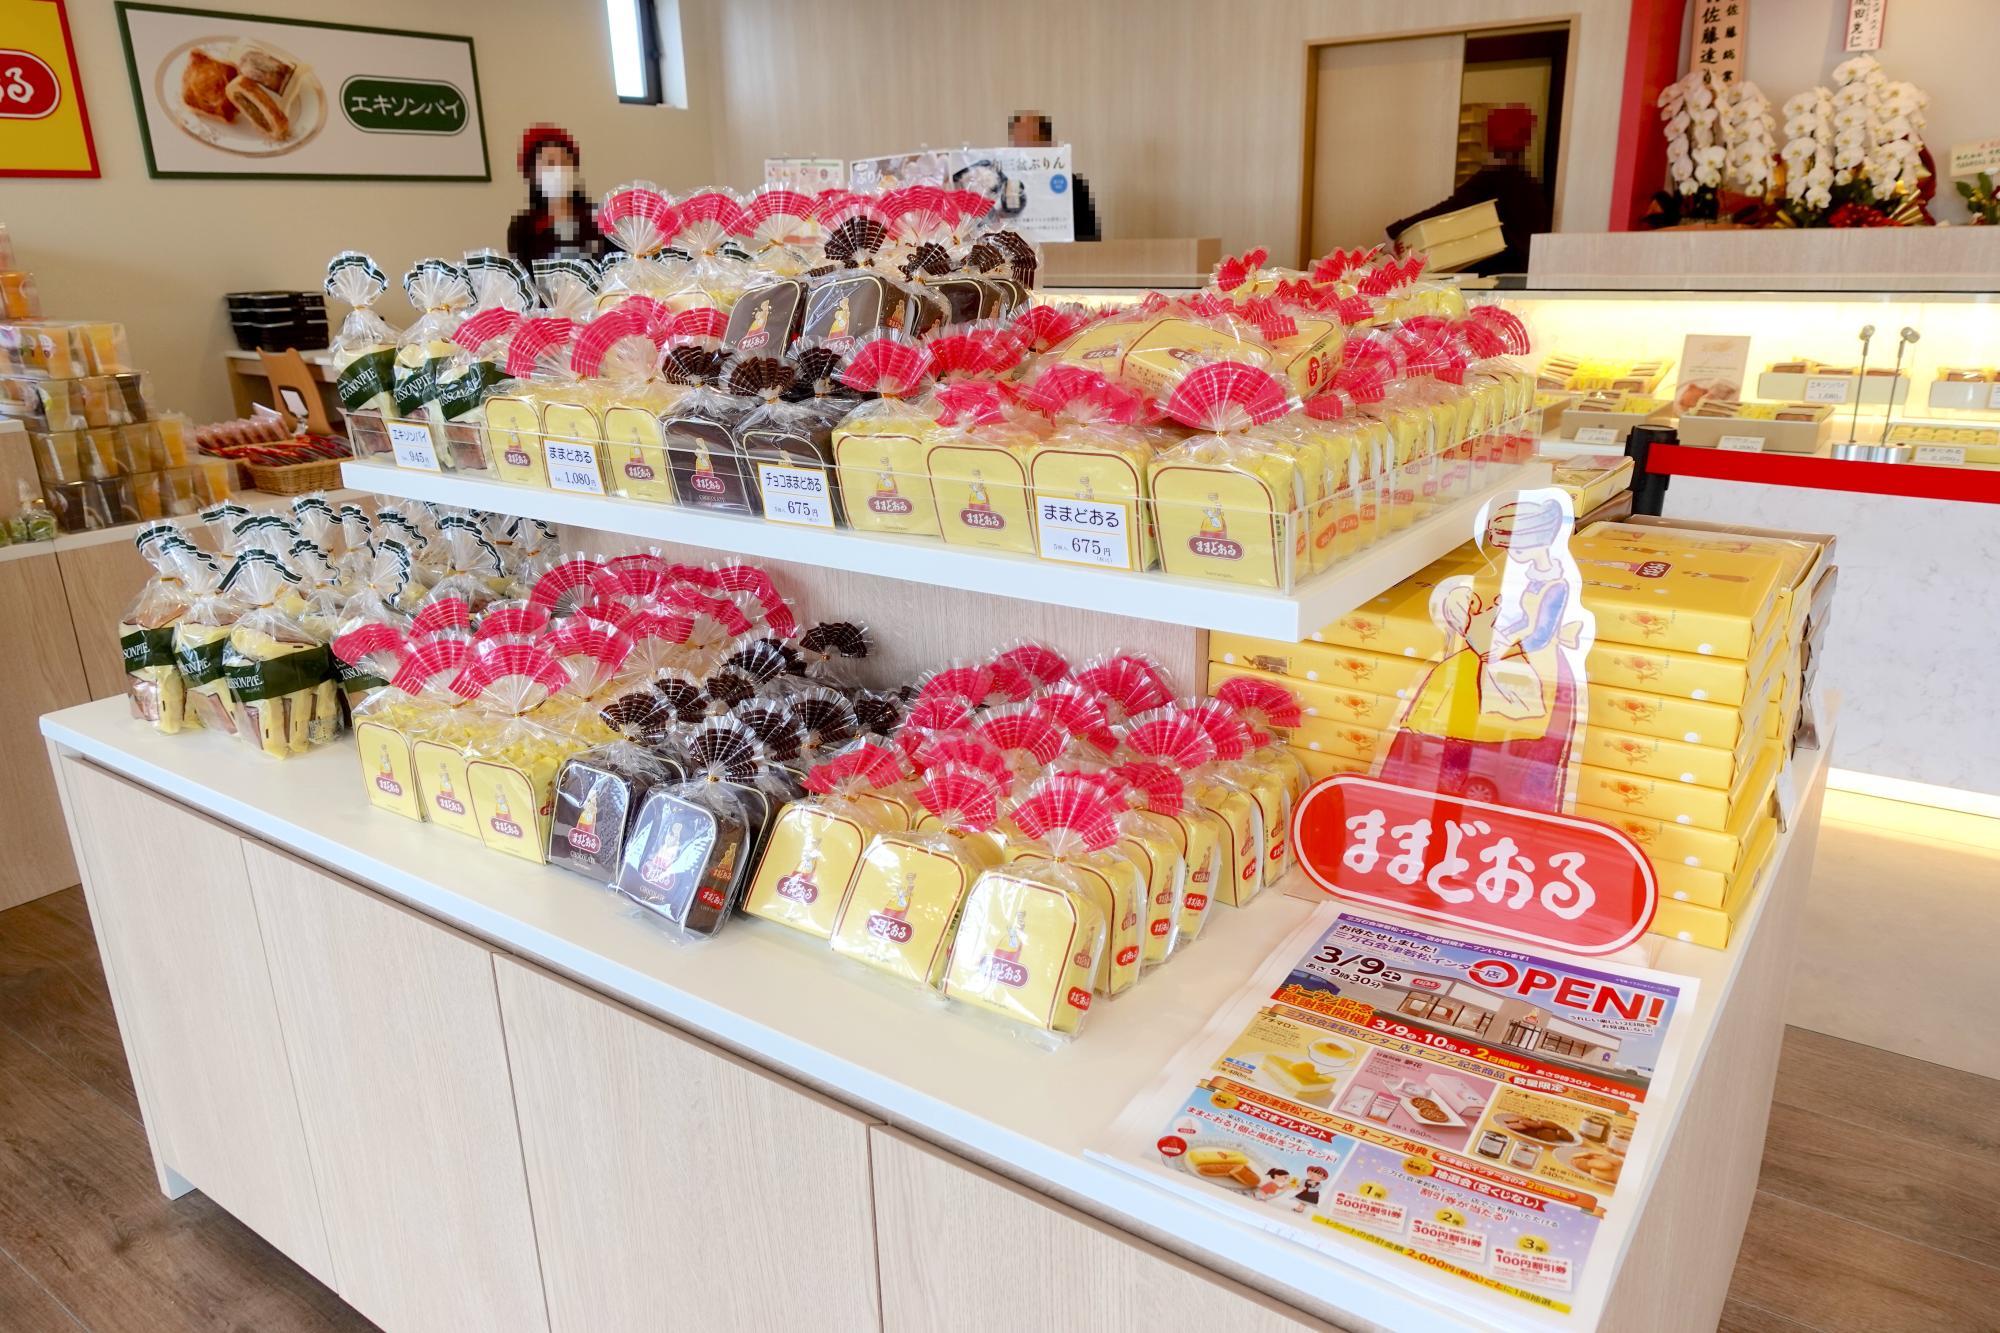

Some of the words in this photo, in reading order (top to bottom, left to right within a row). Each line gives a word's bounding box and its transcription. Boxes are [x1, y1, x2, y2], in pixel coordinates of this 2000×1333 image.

[351, 94, 460, 119] エキソンパイ
[548, 446, 593, 465] ままどおる
[765, 472, 822, 492] チョコままどおる
[1043, 504, 1120, 528] ままどおる
[1195, 540, 1237, 557] ままどおる
[1343, 809, 1596, 920] ままどおる
[1468, 959, 1667, 1025] OPEN!
[1239, 1103, 1327, 1139] お子さまプレゼント
